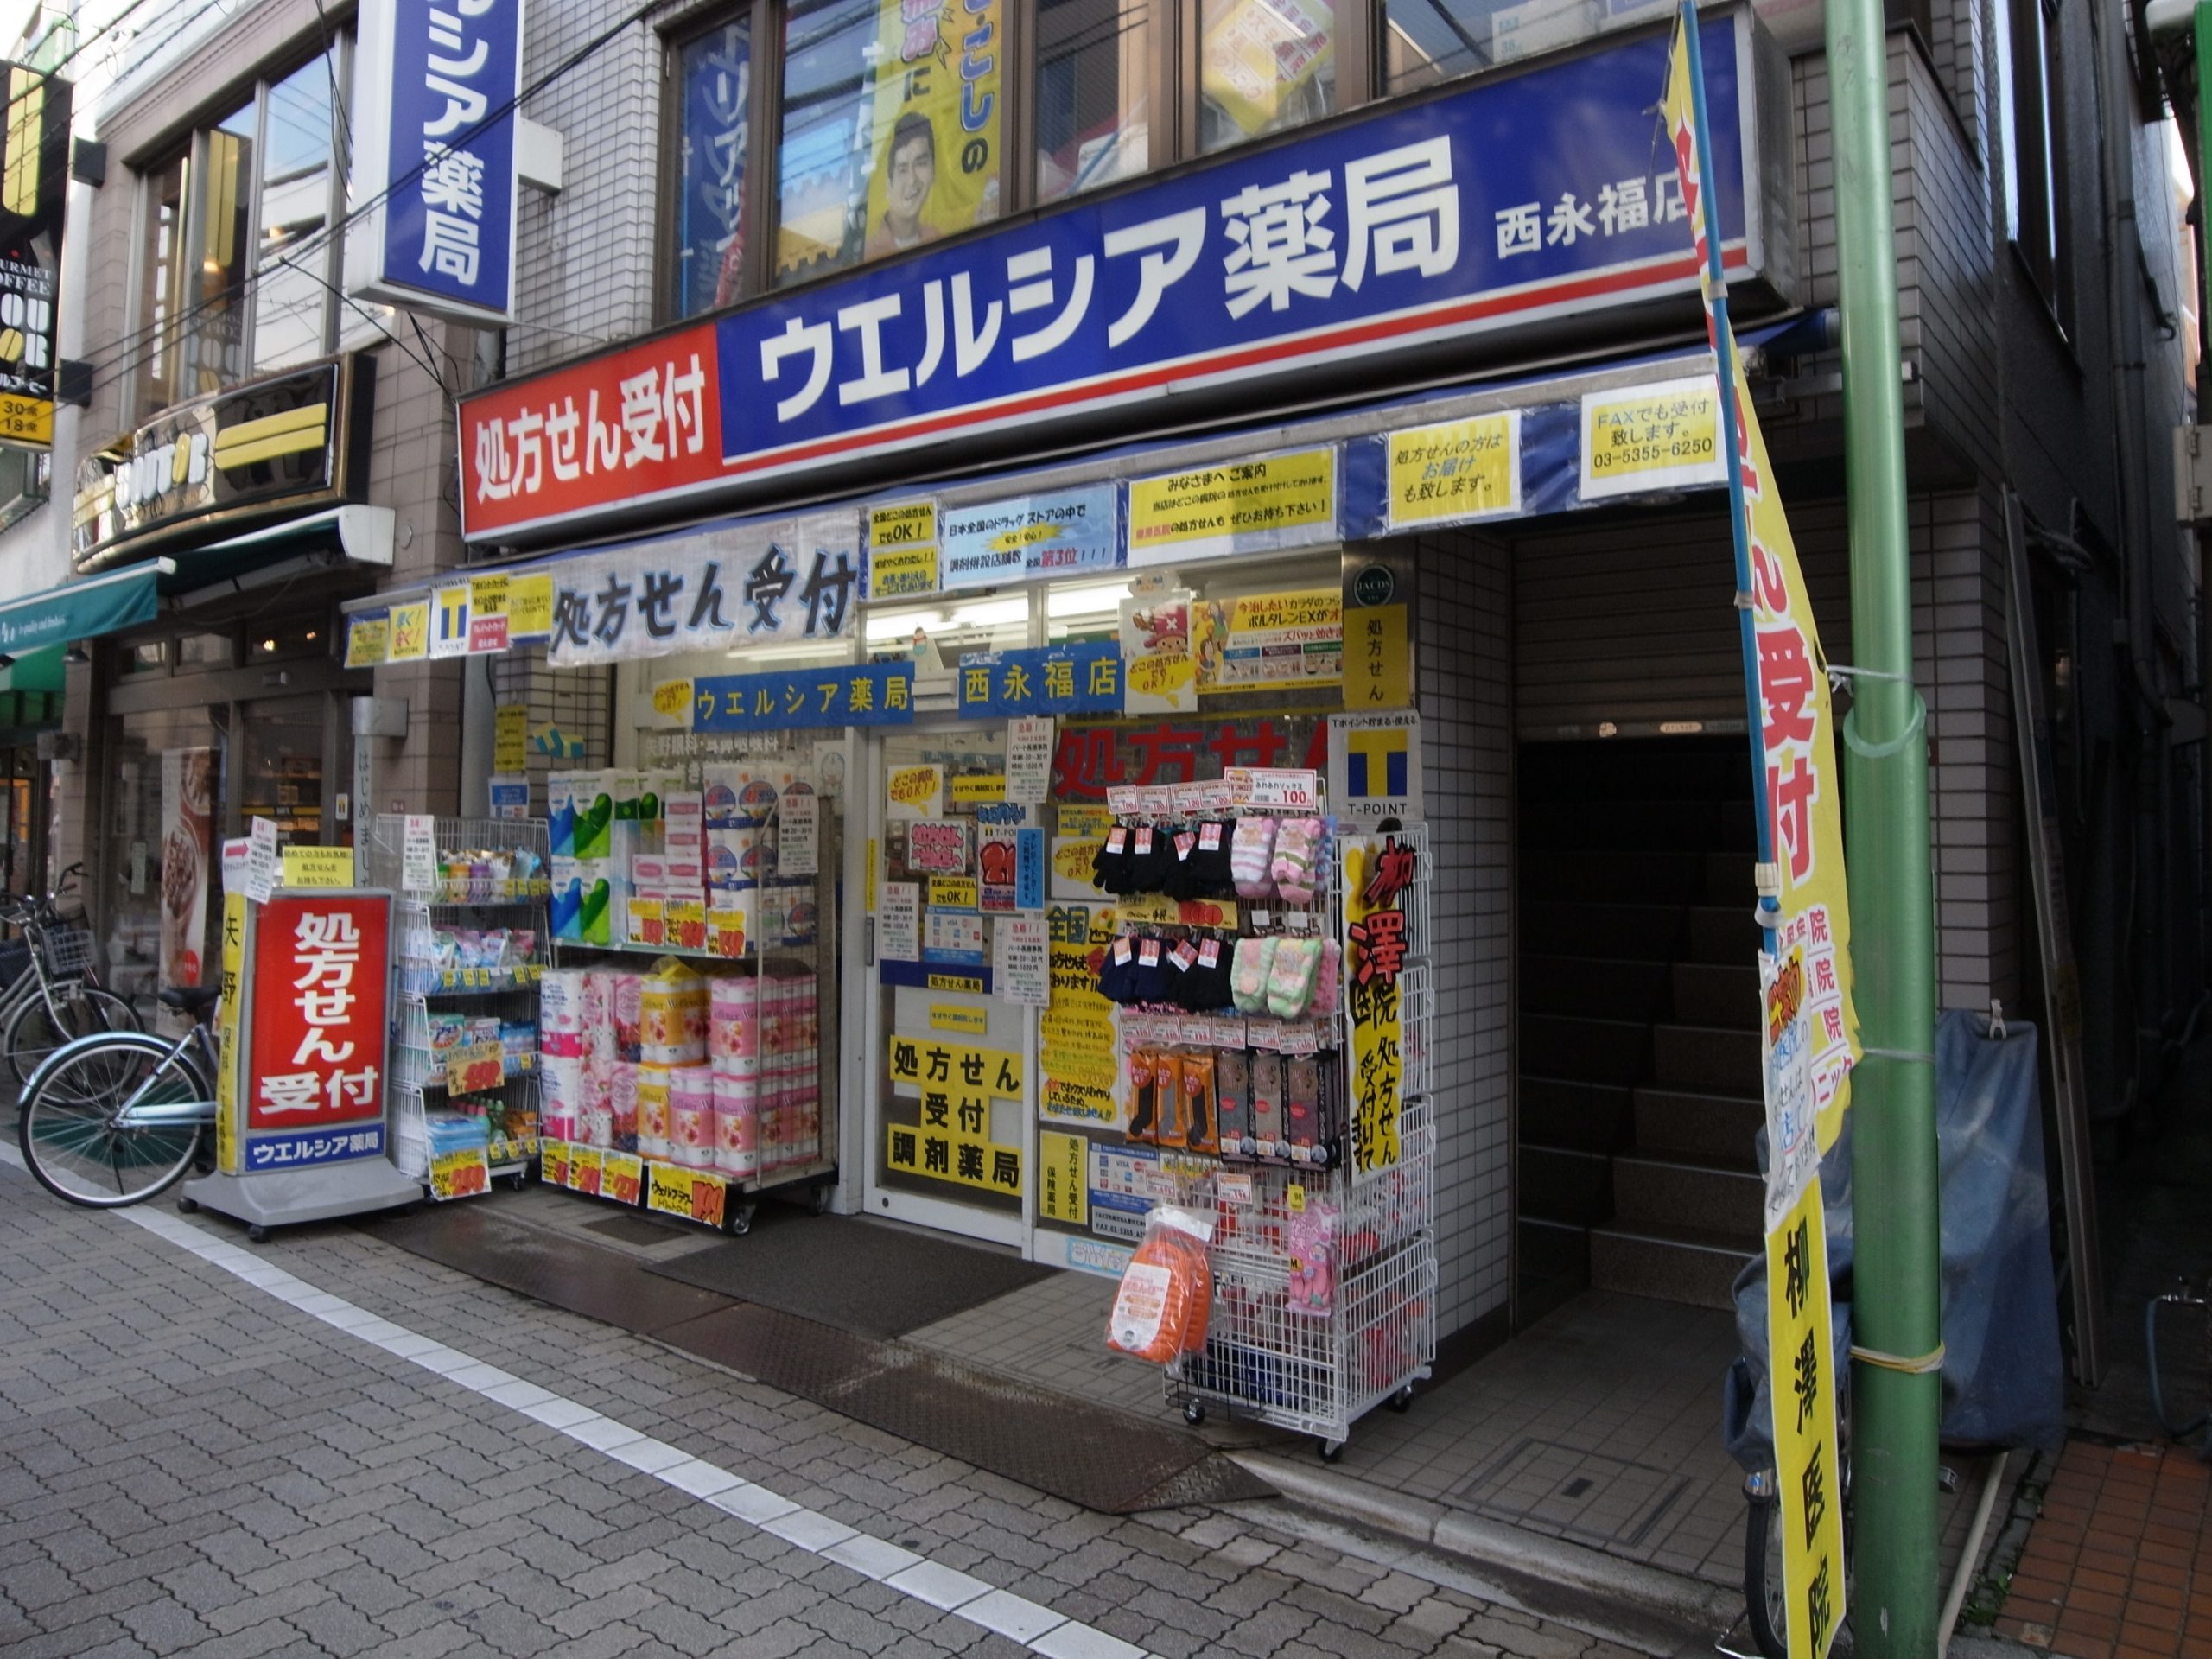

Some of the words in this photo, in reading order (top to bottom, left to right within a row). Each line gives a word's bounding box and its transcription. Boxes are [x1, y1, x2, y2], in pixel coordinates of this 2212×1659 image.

[417, 0, 491, 287] シア薬局
[0, 273, 50, 295] FFEE
[760, 135, 1460, 423] ウエルシア薬局
[474, 354, 706, 505] 処方せん受付
[1598, 397, 1710, 429] FAXでも受付
[1611, 421, 1689, 448] 致します。
[1395, 435, 1502, 467] 処方せんの方は
[1421, 456, 1476, 480] お届け
[1594, 437, 1713, 469] 03-5355-6250
[1167, 472, 1225, 493] みなさまへ
[1230, 462, 1268, 482] ご案内
[949, 516, 1025, 537] 日本全国のドラッグ
[1027, 504, 1087, 525] ストアの中で
[550, 541, 858, 655] 処方せん受付
[965, 656, 1118, 703] 西永福店
[1367, 618, 1384, 702] 処方せん
[696, 676, 908, 721] ウエルシア薬局
[1348, 803, 1408, 816] T-POINT
[291, 912, 360, 1065] 処方せん
[931, 976, 981, 992] 処方せん薬局
[893, 1041, 1020, 1092] 処方せん
[260, 1065, 378, 1116] 受付
[925, 1092, 985, 1135] 受付
[252, 1131, 379, 1164] ウエルシア薬局
[893, 1130, 1020, 1190] 調剤薬局
[1046, 1167, 1057, 1216] 保険薬局
[1068, 1137, 1079, 1220] 処方せん受付
